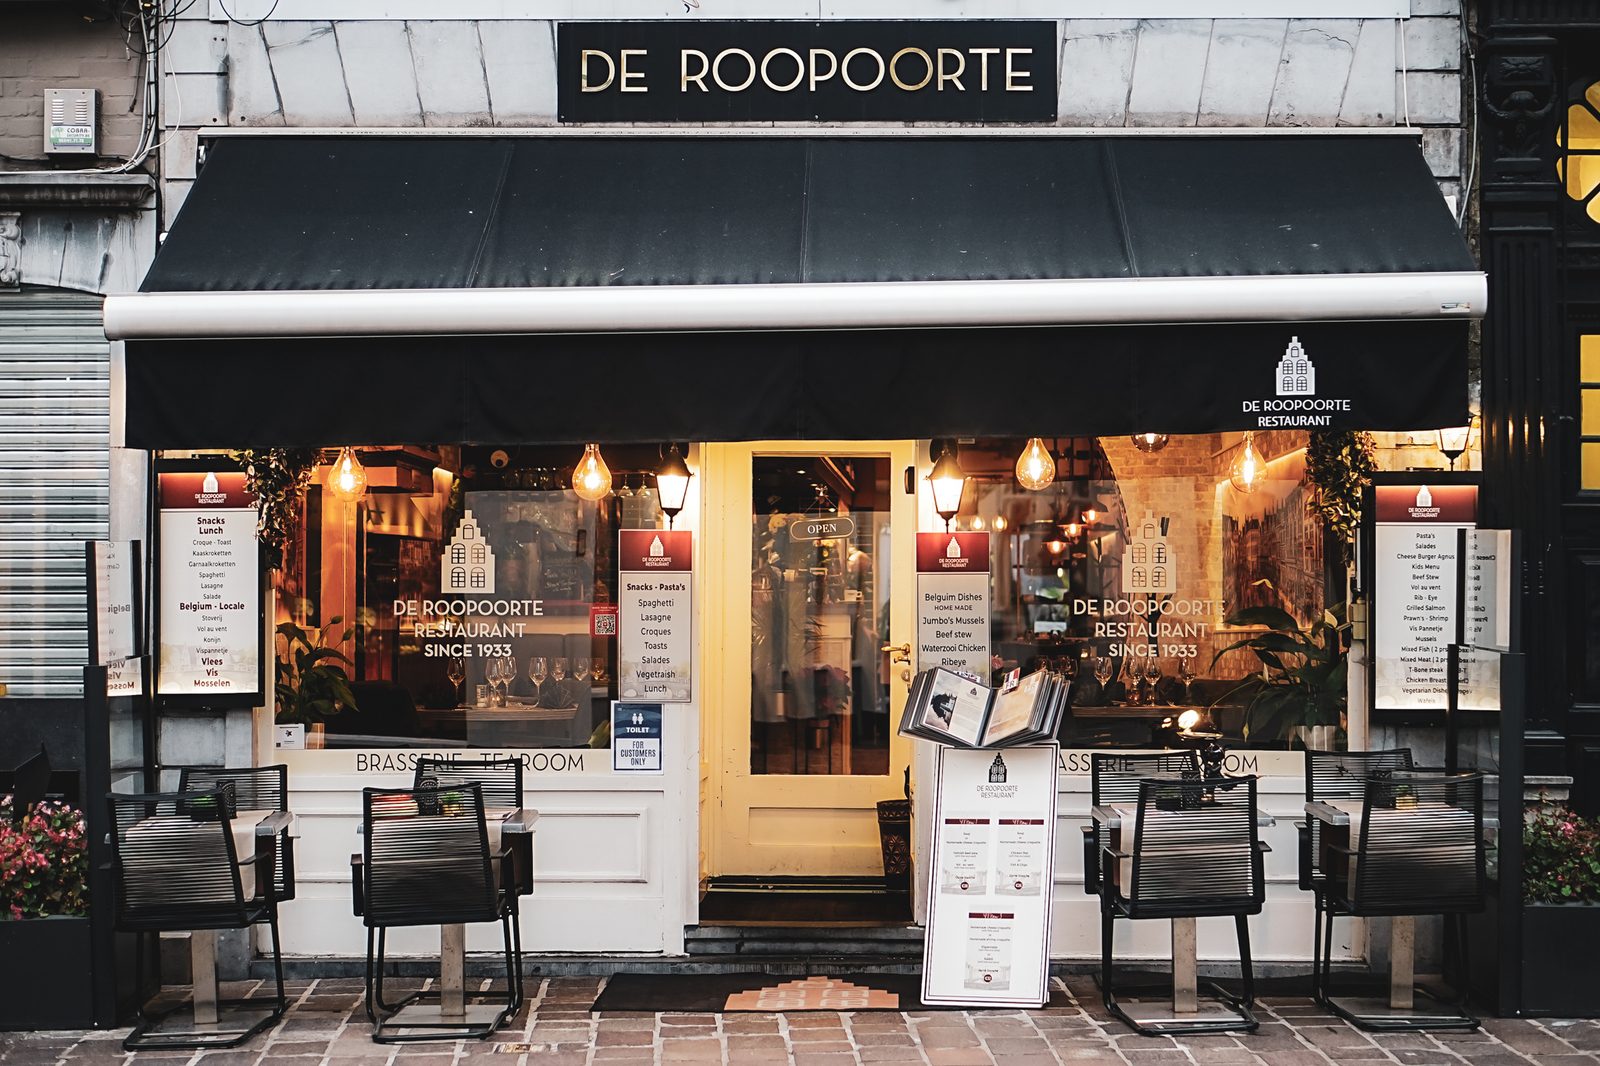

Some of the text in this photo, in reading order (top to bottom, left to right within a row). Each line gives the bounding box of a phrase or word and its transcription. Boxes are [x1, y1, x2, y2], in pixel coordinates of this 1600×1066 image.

[580, 47, 1034, 92] DE ROOPOORTE
[1242, 400, 1351, 412] DE ROOPOORTE
[1258, 416, 1332, 427] RESTAURANT
[808, 524, 837, 534] OPEN
[925, 593, 955, 602] Belguim
[180, 602, 212, 612] Belgium
[394, 600, 544, 616] DE ROOPOORTE
[638, 599, 674, 608] Spaghetti
[1074, 600, 1225, 616] DE ROOPOORTE
[641, 614, 671, 622] Lasagne
[414, 623, 526, 638] RESTAURANT
[641, 628, 671, 636] Croques
[1095, 622, 1208, 638] RESTAURANT
[424, 644, 512, 657] SINCE 1933
[1108, 644, 1197, 657] SINCE 1933
[942, 658, 966, 667] Ribeye
[206, 668, 218, 676] Vis
[636, 670, 675, 680] Vegetraish
[357, 753, 462, 771] BRASSRIE
